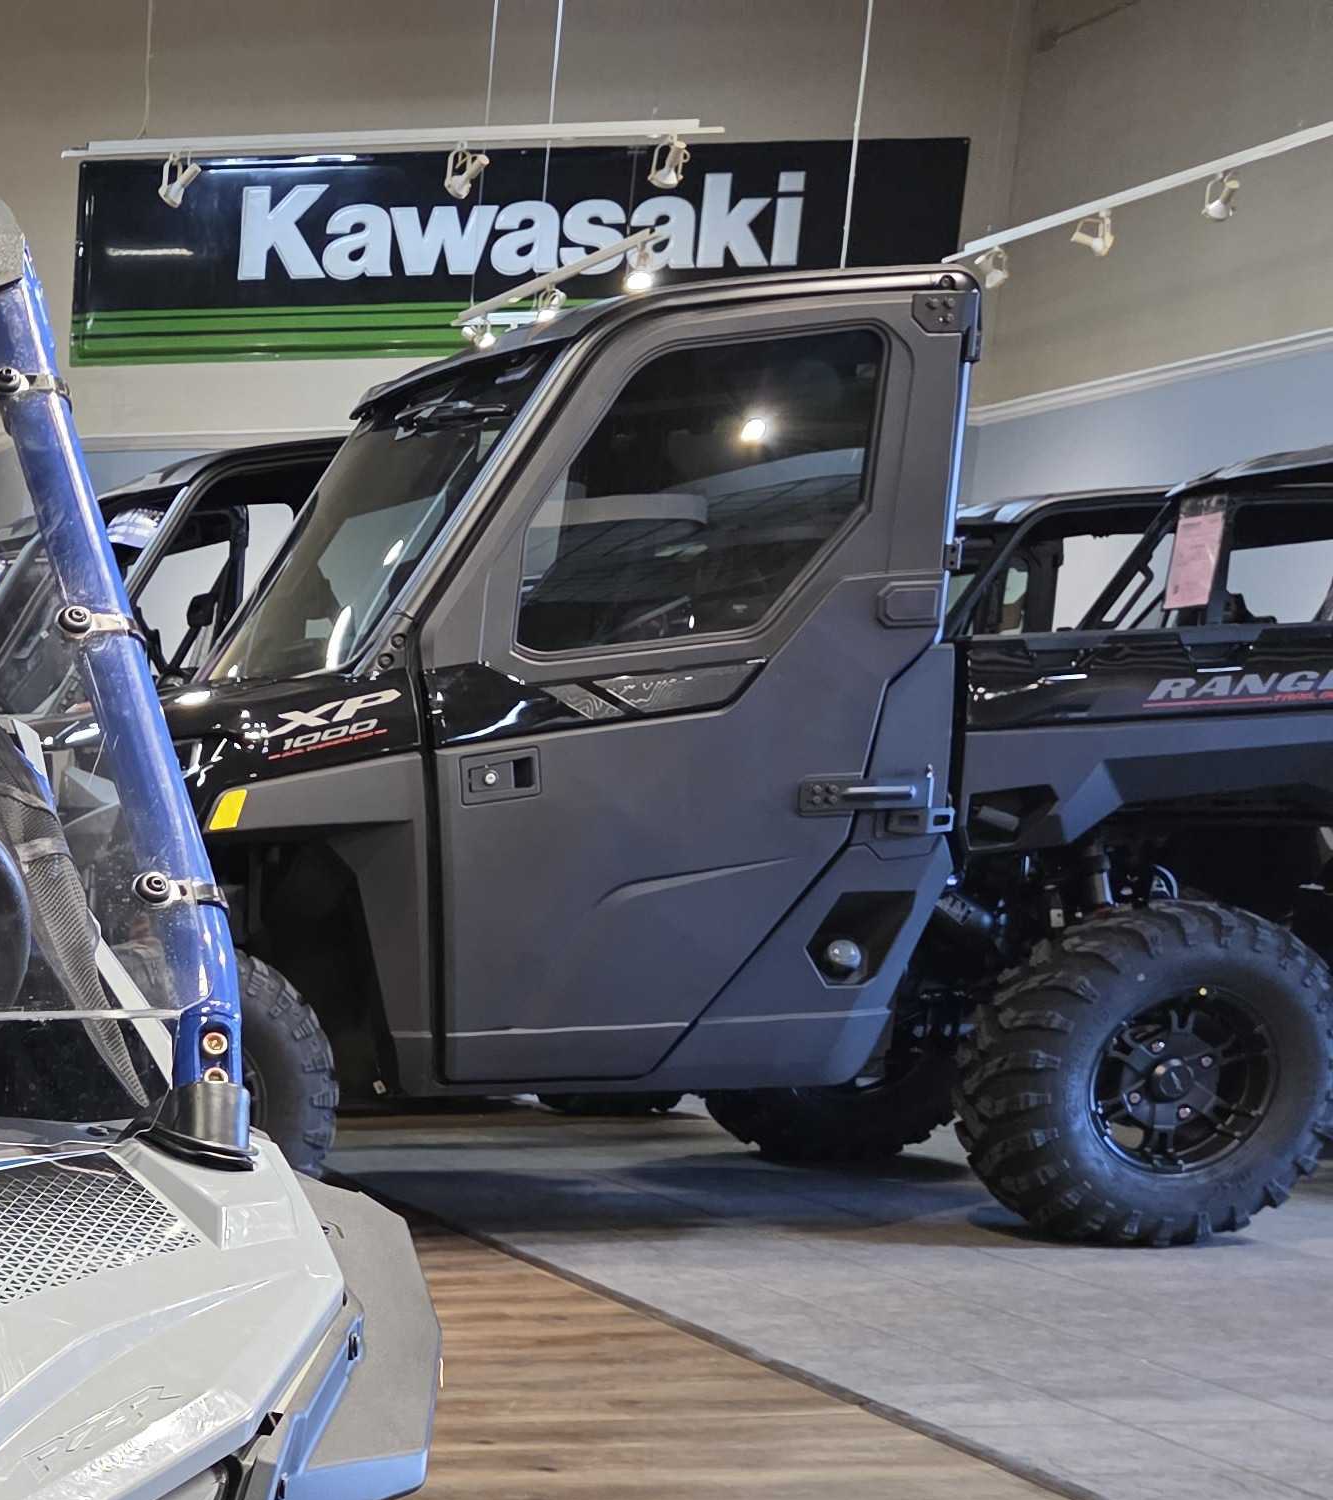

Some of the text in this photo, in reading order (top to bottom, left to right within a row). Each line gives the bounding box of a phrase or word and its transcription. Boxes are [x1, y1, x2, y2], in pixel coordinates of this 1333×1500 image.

[237, 171, 806, 281] Kawasaki
[266, 689, 402, 738] XP
[283, 718, 379, 750] 1000
